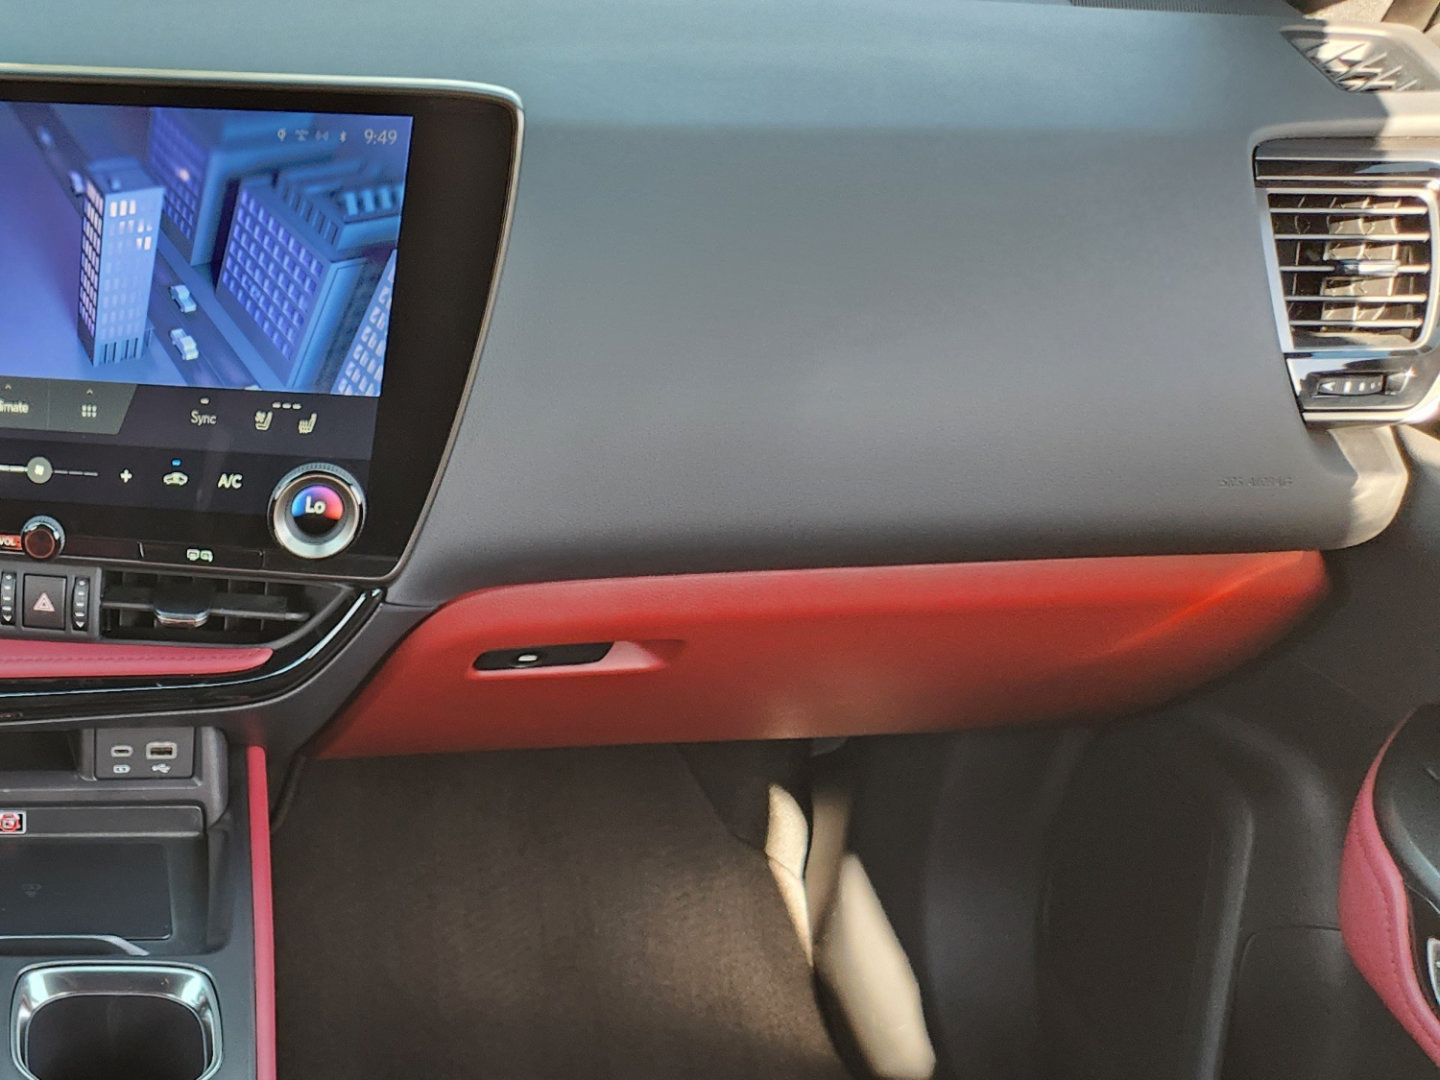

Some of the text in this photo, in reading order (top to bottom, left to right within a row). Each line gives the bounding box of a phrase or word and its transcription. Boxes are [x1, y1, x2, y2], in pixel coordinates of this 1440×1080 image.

[363, 128, 398, 145] 9:49
[190, 410, 217, 426] Sync
[217, 473, 242, 489] A/C
[305, 495, 326, 514] Lo
